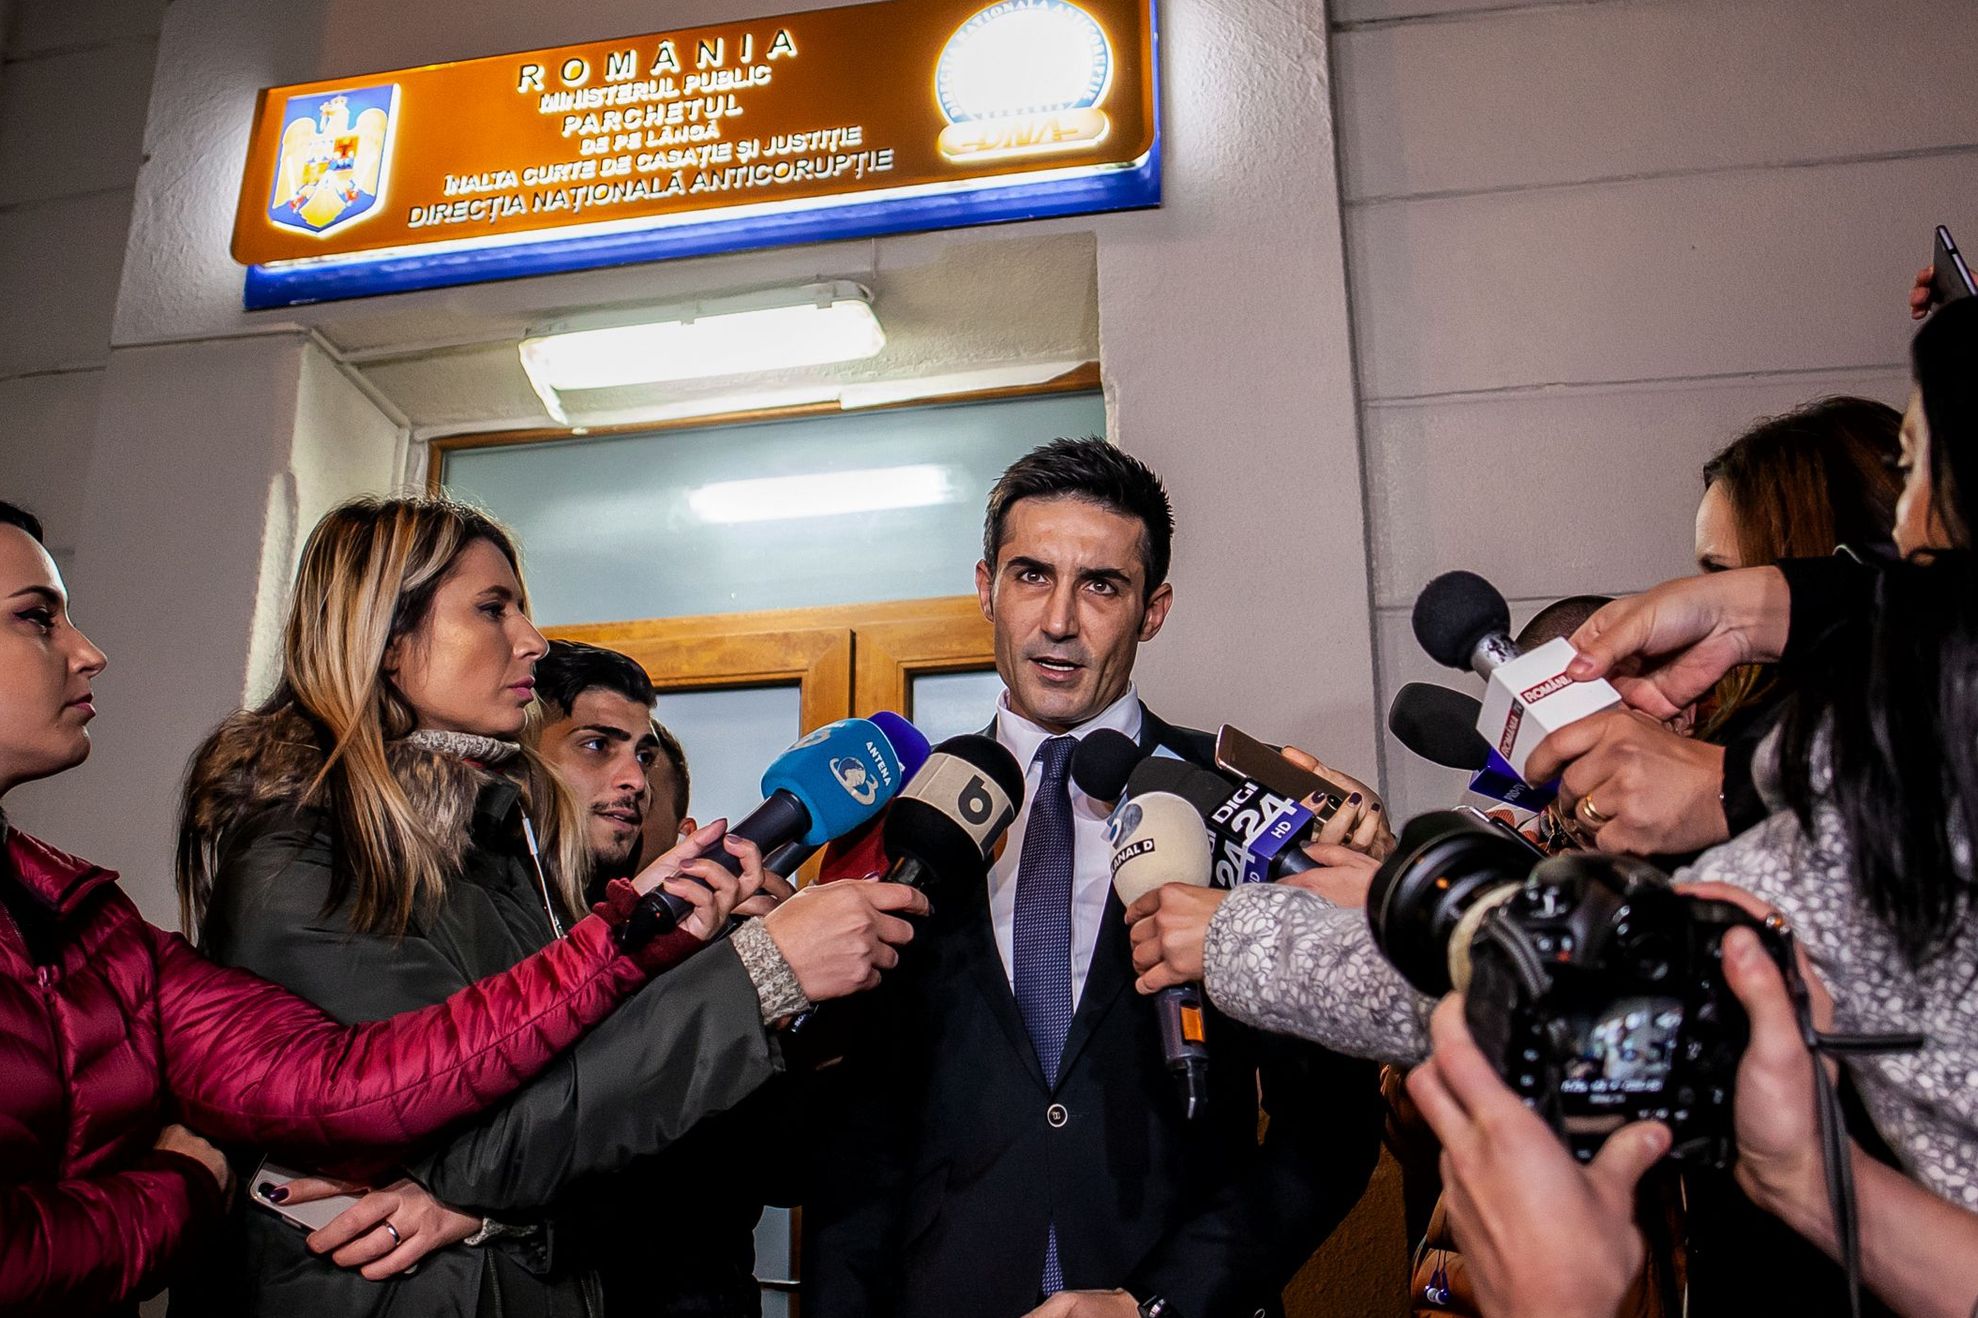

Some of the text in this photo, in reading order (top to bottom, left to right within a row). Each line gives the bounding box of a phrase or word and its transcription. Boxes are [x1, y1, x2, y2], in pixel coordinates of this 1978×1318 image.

[540, 65, 773, 114] MINISTERUL PUBLIC
[562, 94, 744, 137] PARCHETUL
[580, 137, 609, 155] DE
[614, 131, 642, 151] PE
[522, 159, 598, 186] CURTE
[600, 155, 632, 177] DE
[865, 741, 892, 787] ANTENA
[1211, 781, 1260, 825] DIGI
[1231, 793, 1299, 846] 24
[1143, 840, 1154, 851] D
[1270, 821, 1292, 839] HD
[1216, 838, 1257, 891] 24
